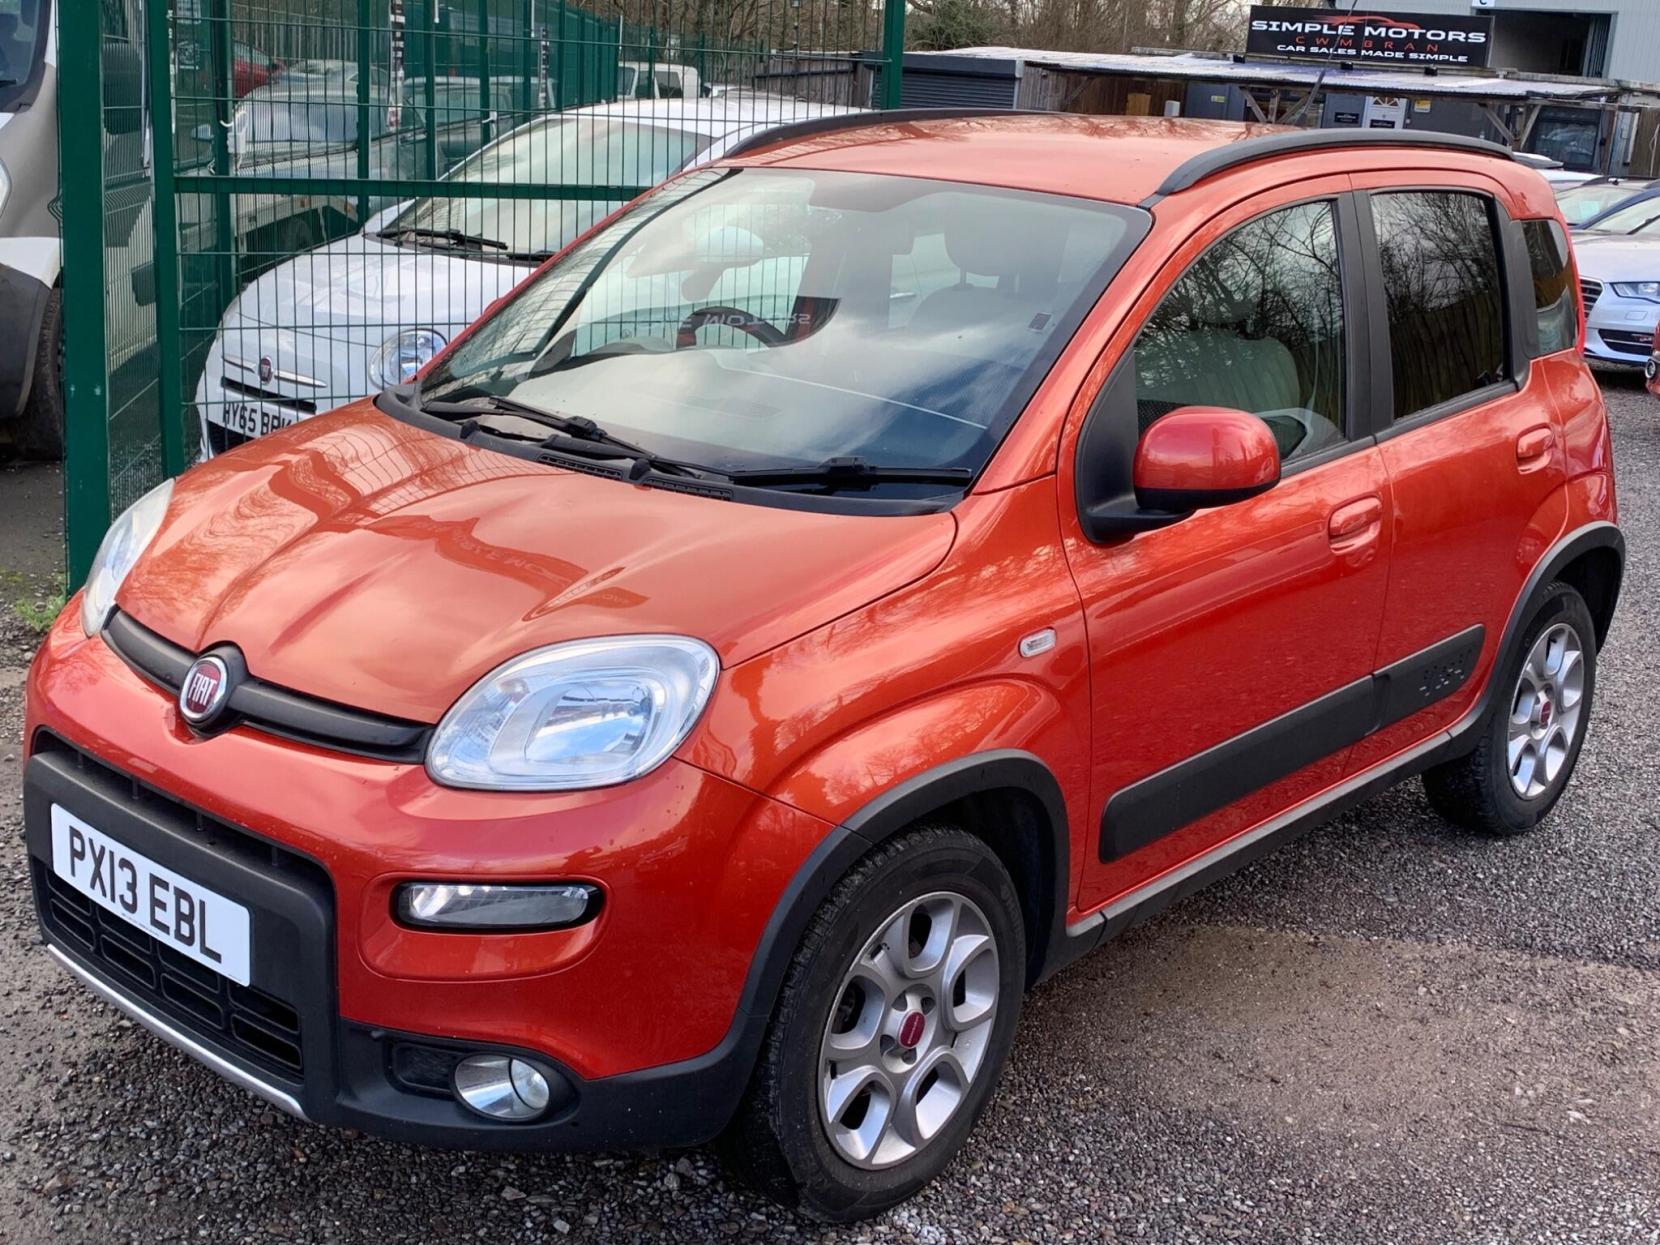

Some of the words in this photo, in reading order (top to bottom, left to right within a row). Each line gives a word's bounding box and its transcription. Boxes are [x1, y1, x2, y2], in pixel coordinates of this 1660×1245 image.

[1251, 20, 1355, 36] SIMPLE
[1364, 26, 1486, 43] MOTORS
[1295, 35, 1439, 53] CWMBRAN
[1276, 44, 1306, 52] CAR
[1309, 46, 1357, 56] SALES
[1361, 50, 1405, 59] MADE
[1408, 52, 1468, 62] SIMPLE
[222, 401, 258, 433] HY65
[187, 672, 218, 706] FIAT
[68, 825, 138, 915] PX13
[149, 872, 223, 964] EBL
